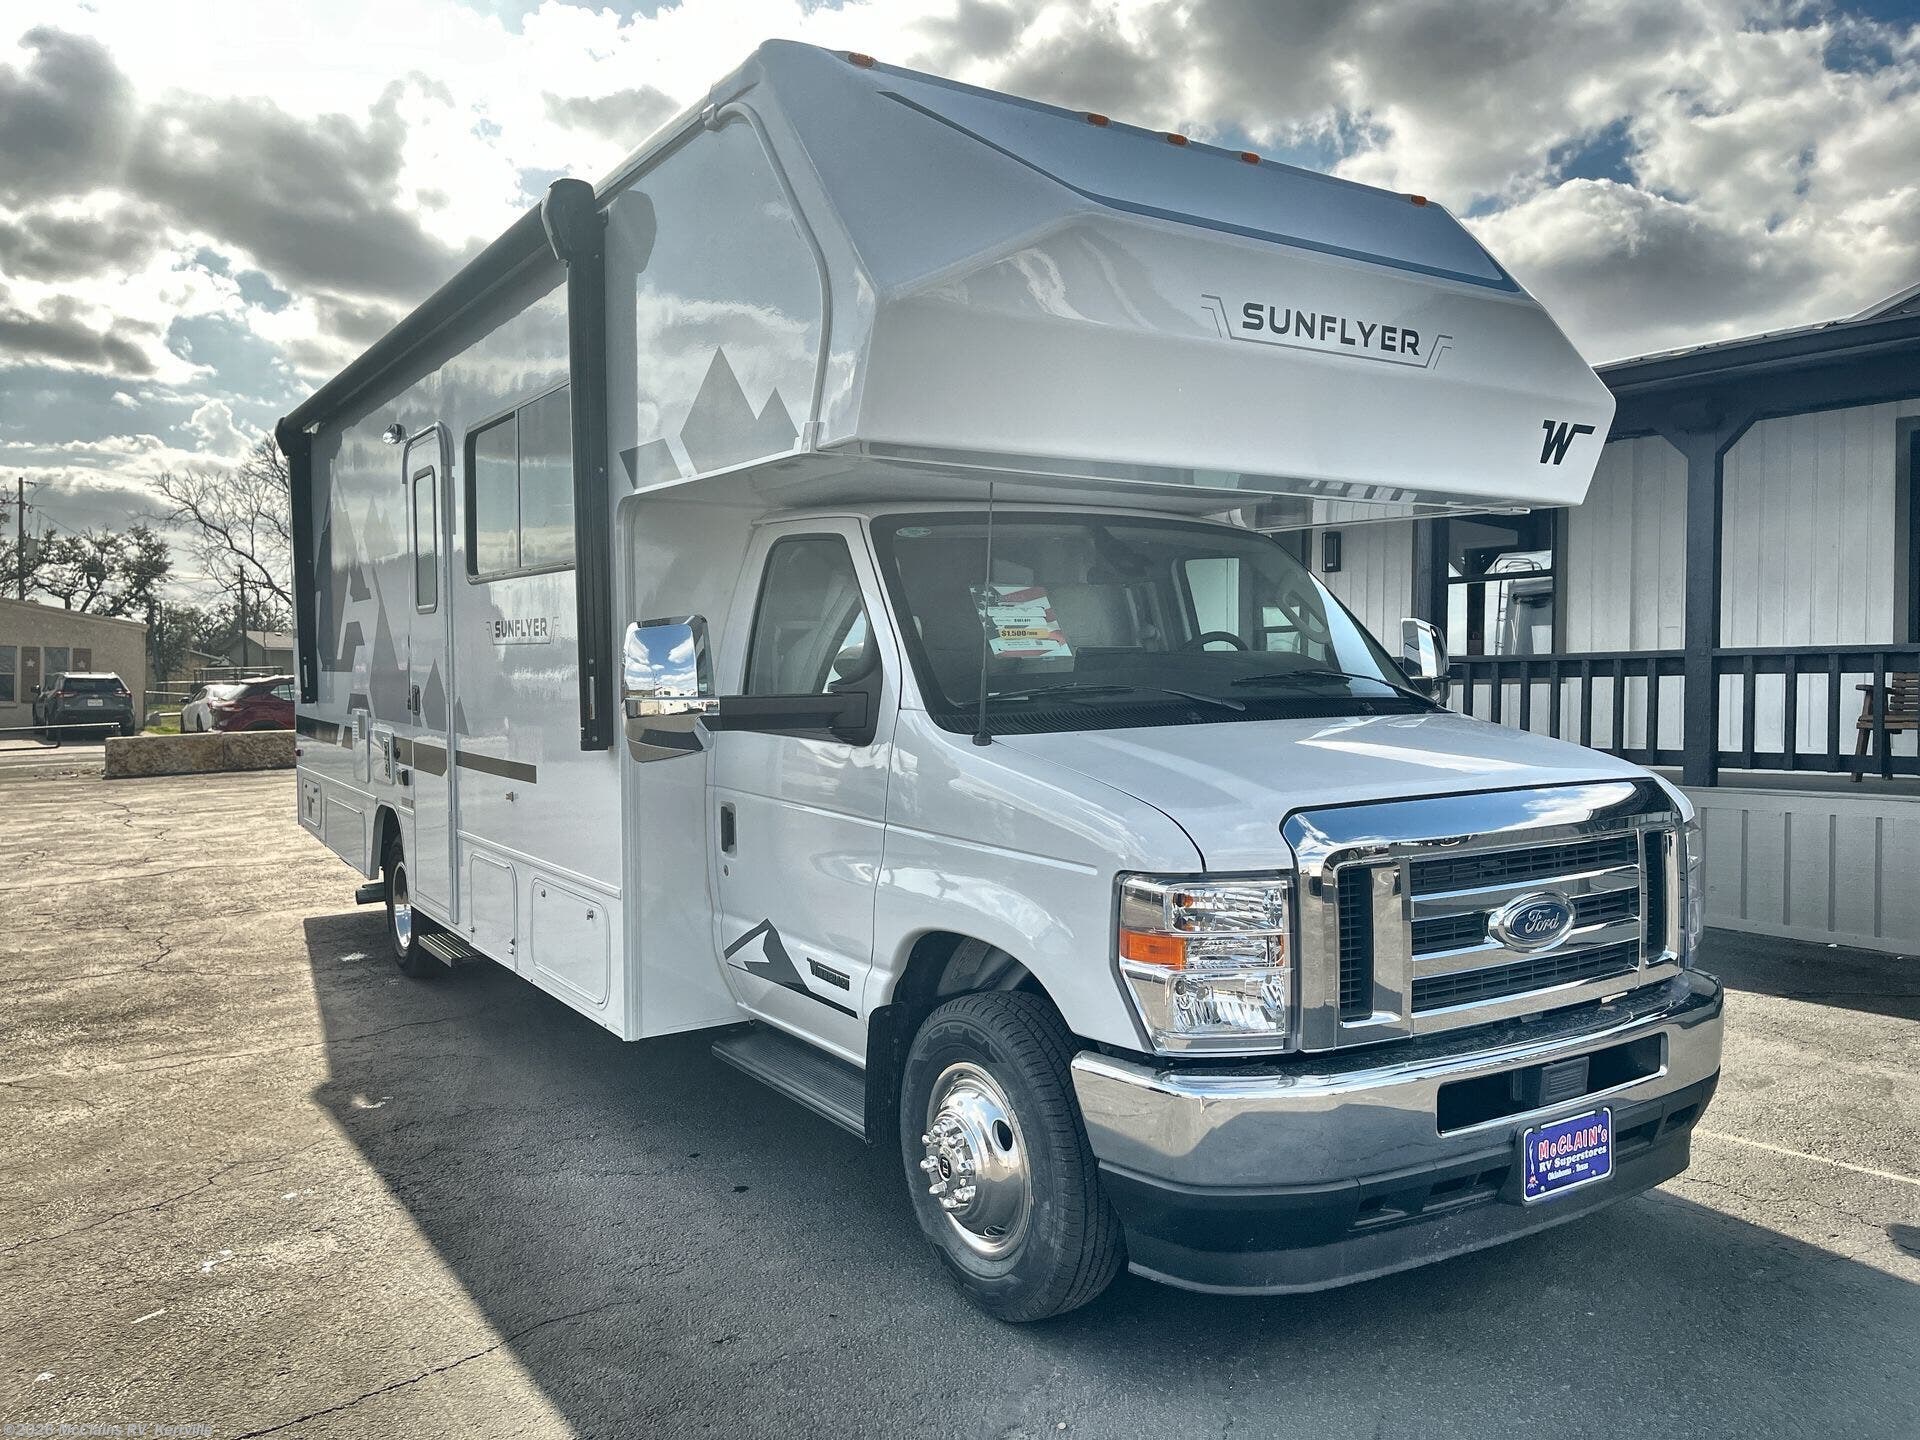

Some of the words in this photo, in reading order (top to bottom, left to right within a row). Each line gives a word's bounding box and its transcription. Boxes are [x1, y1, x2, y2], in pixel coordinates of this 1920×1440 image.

[1242, 302, 1420, 356] SUNFLYER
[1540, 419, 1596, 466] W
[494, 617, 548, 638] SUNFLYER
[1525, 908, 1560, 934] Ford
[1538, 1159, 1553, 1173] RV
[1553, 1145, 1607, 1168] Superstores
